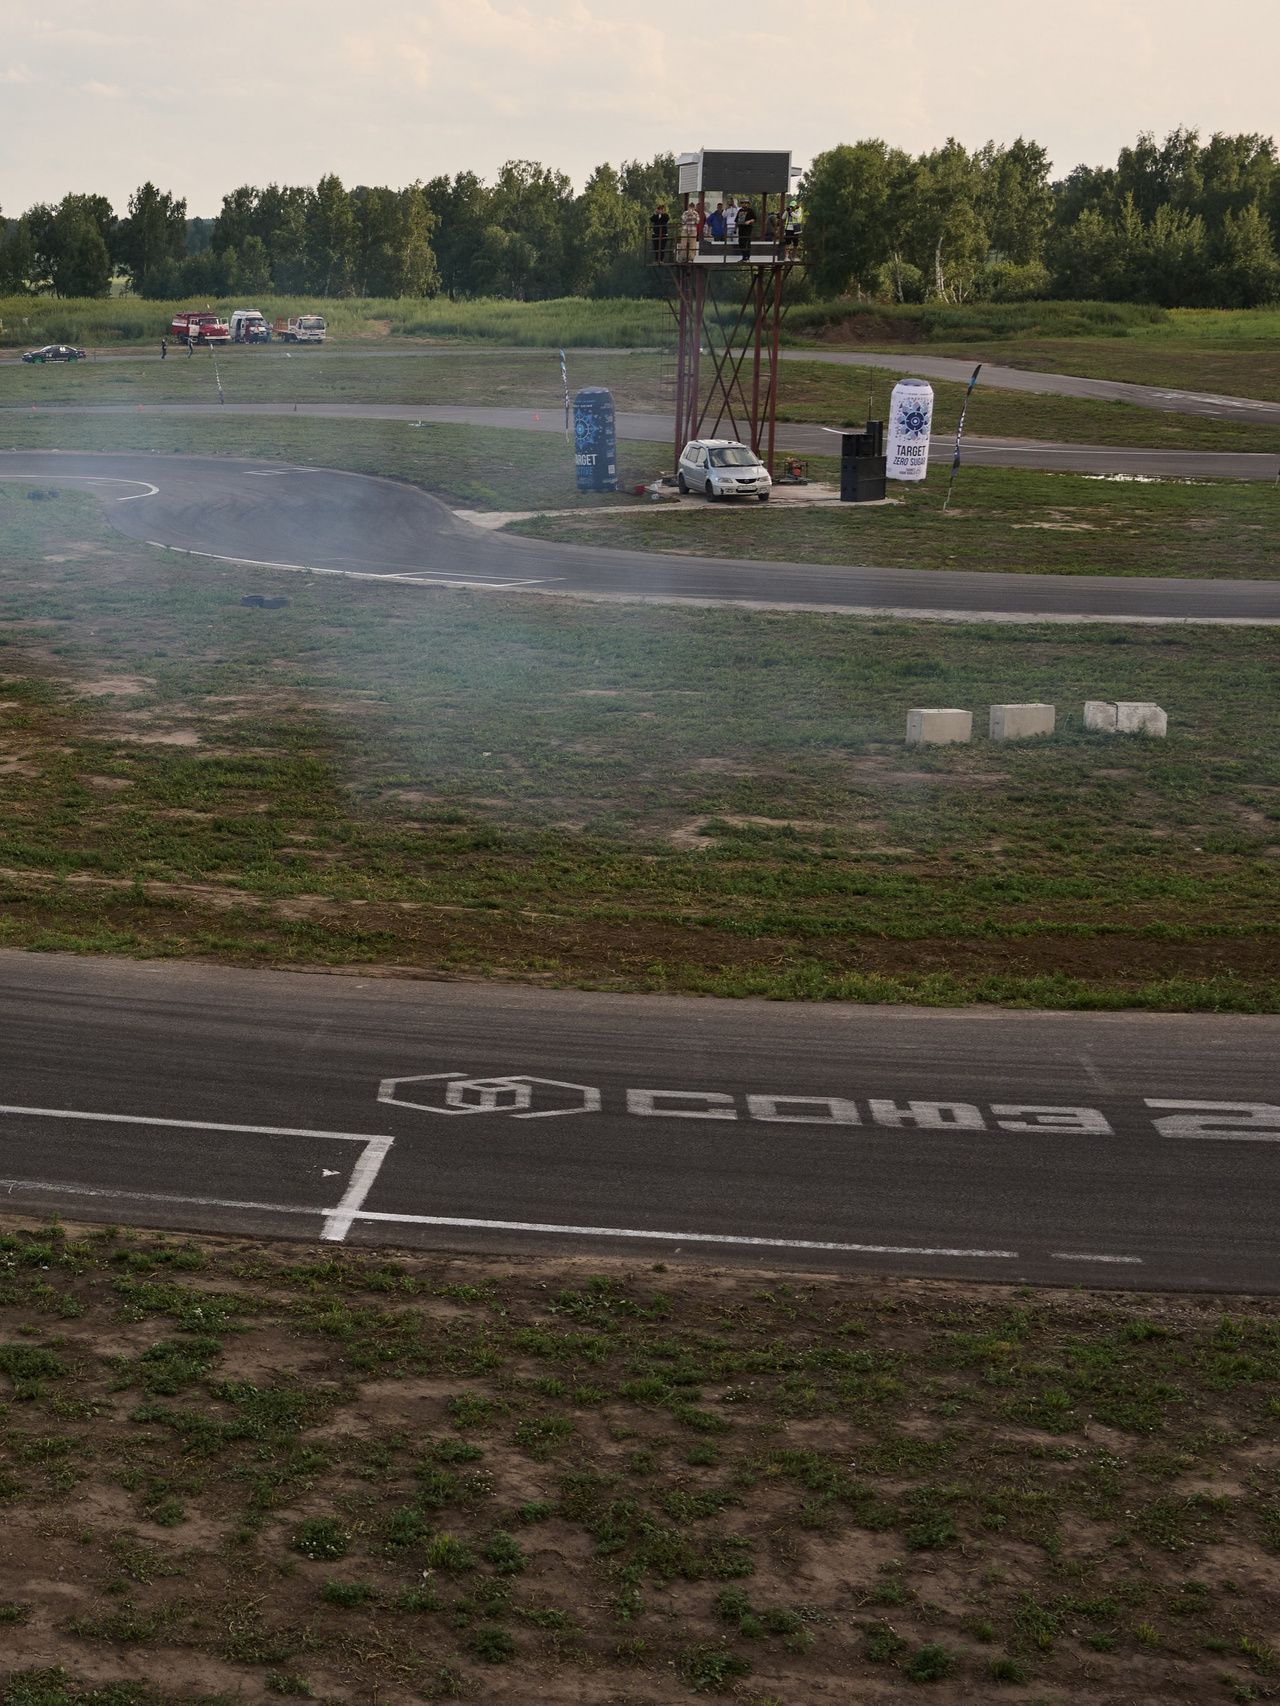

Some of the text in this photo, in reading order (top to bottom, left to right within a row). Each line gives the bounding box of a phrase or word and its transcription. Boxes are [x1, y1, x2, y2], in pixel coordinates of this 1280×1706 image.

[897, 444, 926, 457] TARGET
[893, 456, 908, 466] ZERO
[626, 1087, 1117, 1137] СОЮЗ
